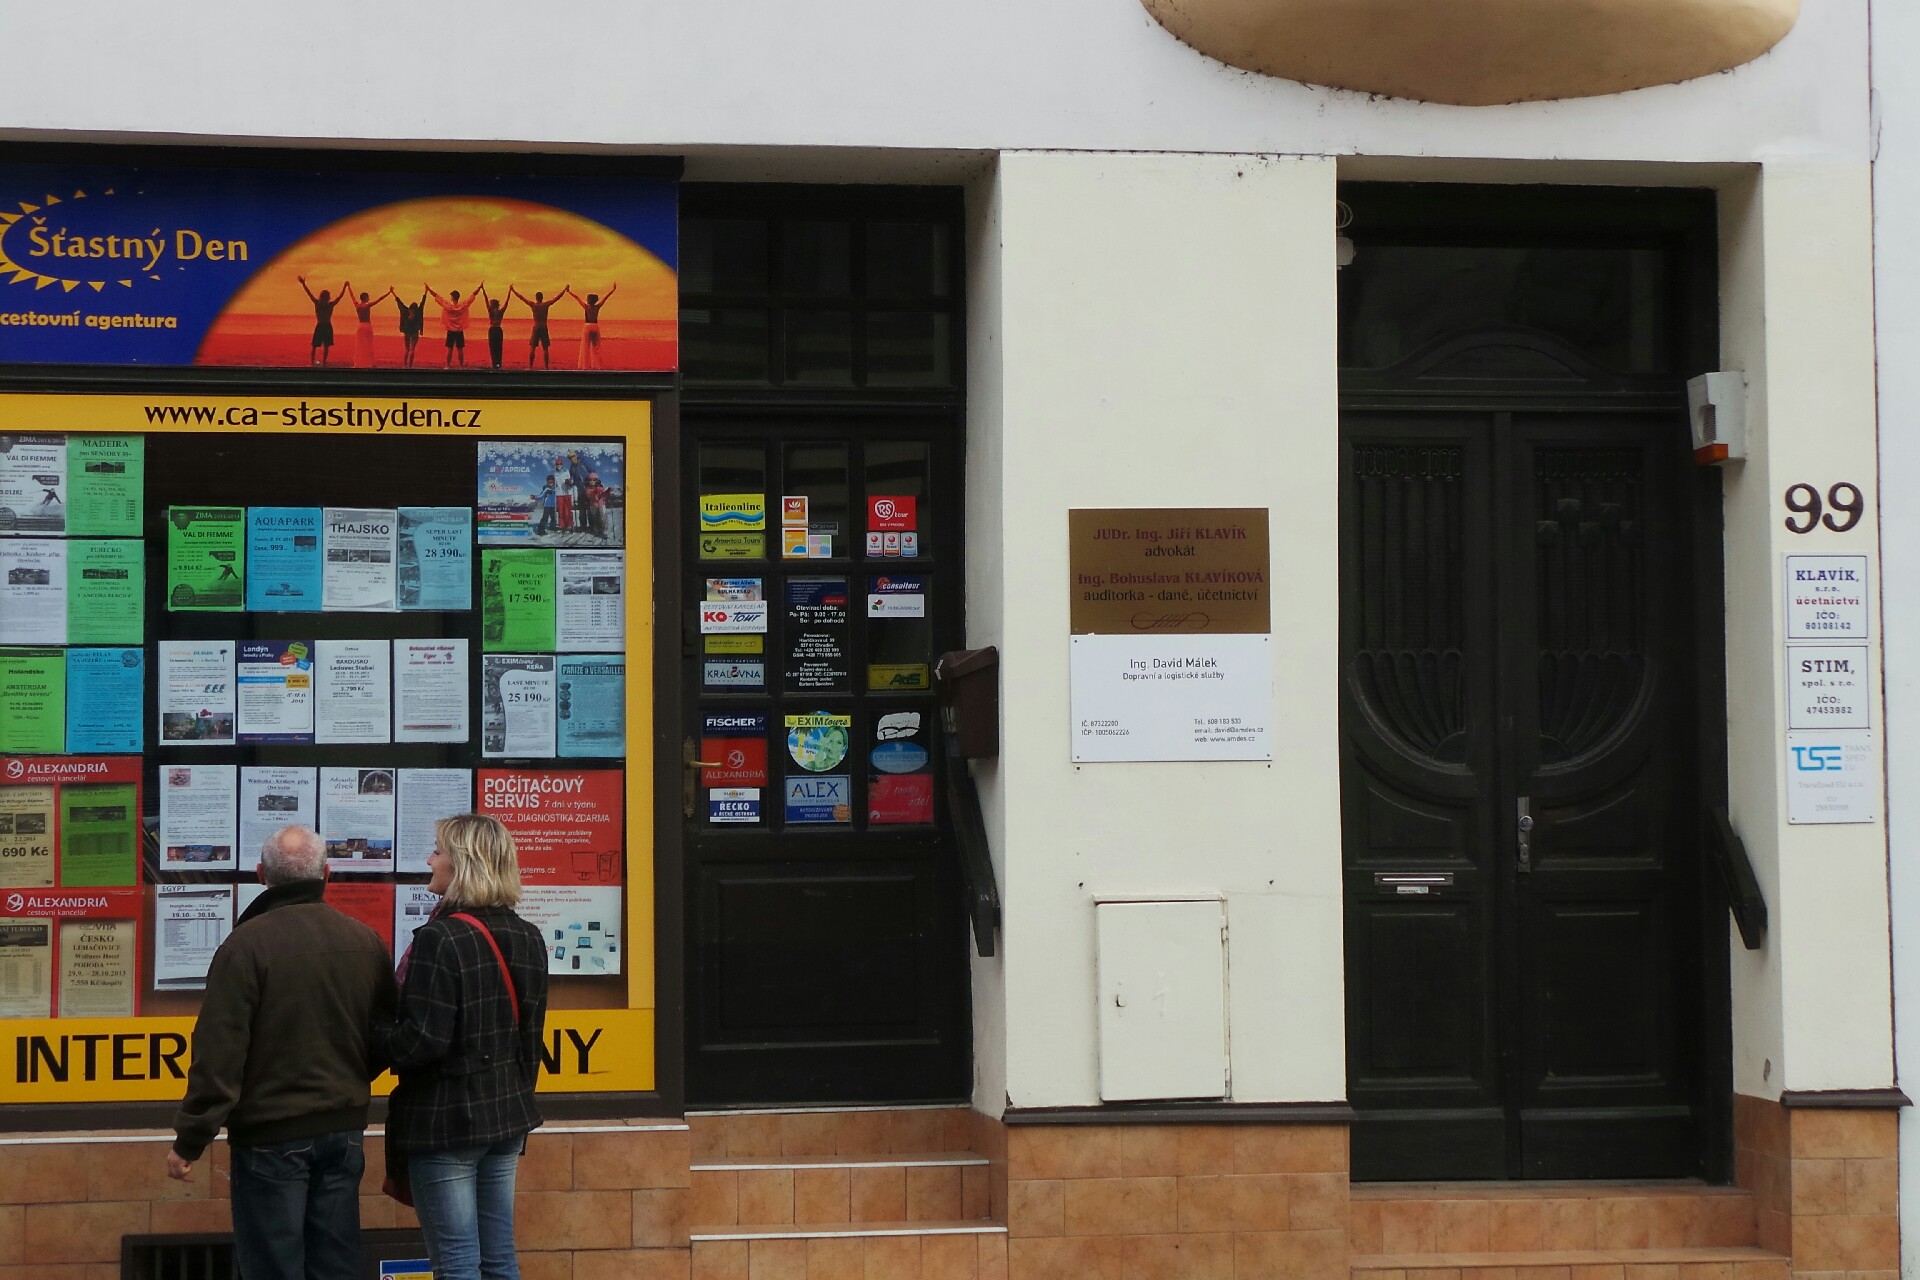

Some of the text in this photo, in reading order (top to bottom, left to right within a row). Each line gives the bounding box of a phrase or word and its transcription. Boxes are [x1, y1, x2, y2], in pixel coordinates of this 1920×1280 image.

[28, 216, 249, 269] Šťastný Den
[0, 310, 177, 330] cestovní agentura
[143, 400, 483, 431] www.ca-stastnyden.cz
[82, 440, 129, 448] MADEIRA
[877, 503, 892, 515] RS
[1784, 481, 1864, 535] 99
[195, 511, 213, 519] ZIMA
[254, 517, 315, 527] AQUAPARK
[330, 523, 390, 535] THAJSKO
[1093, 525, 1247, 542] JUDr. Ing. Jiří KLAVÍK
[744, 536, 761, 544] Tours
[424, 548, 459, 558] 28 390
[1144, 545, 1196, 557] advokát
[1078, 568, 1264, 586] Ing. Bohuslava KLAVÍKOVÁ
[1795, 566, 1860, 583] KLAVÍK,
[508, 594, 542, 603] 17 590
[1083, 588, 1258, 603] auditorka daně, účetnictví
[1796, 595, 1860, 605] účetnictví
[1815, 609, 1840, 620] IČO:
[243, 645, 269, 653] Londýn
[1130, 656, 1218, 672] Ing. David Málek
[1801, 659, 1855, 675] STIM,
[1122, 672, 1156, 682] Dopravní
[1164, 671, 1199, 681] logistické
[1200, 671, 1225, 681] služby
[1801, 679, 1826, 688] spol.
[507, 692, 542, 703] 25 190
[1816, 692, 1841, 704] IČO:
[706, 717, 756, 727] FISCHER
[27, 762, 109, 774] ALEXANDRIA
[27, 774, 87, 783] cestovní kancelář
[705, 770, 765, 779] ALEXANDRIA
[484, 774, 585, 794] POČÍTAČOVÝ
[791, 781, 839, 798] ALEX
[484, 793, 540, 809] SERVIS
[551, 800, 565, 809] dní
[573, 800, 597, 811] týdnu
[719, 801, 750, 811] ŘECKO
[517, 813, 574, 823] DIAGNOSTIKA
[575, 813, 610, 823] ZDARMA
[2, 846, 49, 858] 690 Kč
[161, 885, 187, 893] EGYPT
[27, 896, 109, 908] ALEXANDRIA
[80, 933, 115, 943] ČESKO
[73, 943, 121, 951] LUHAČOVICE
[67, 970, 84, 978] 29.9.
[16, 1029, 603, 1083] INTER NY
